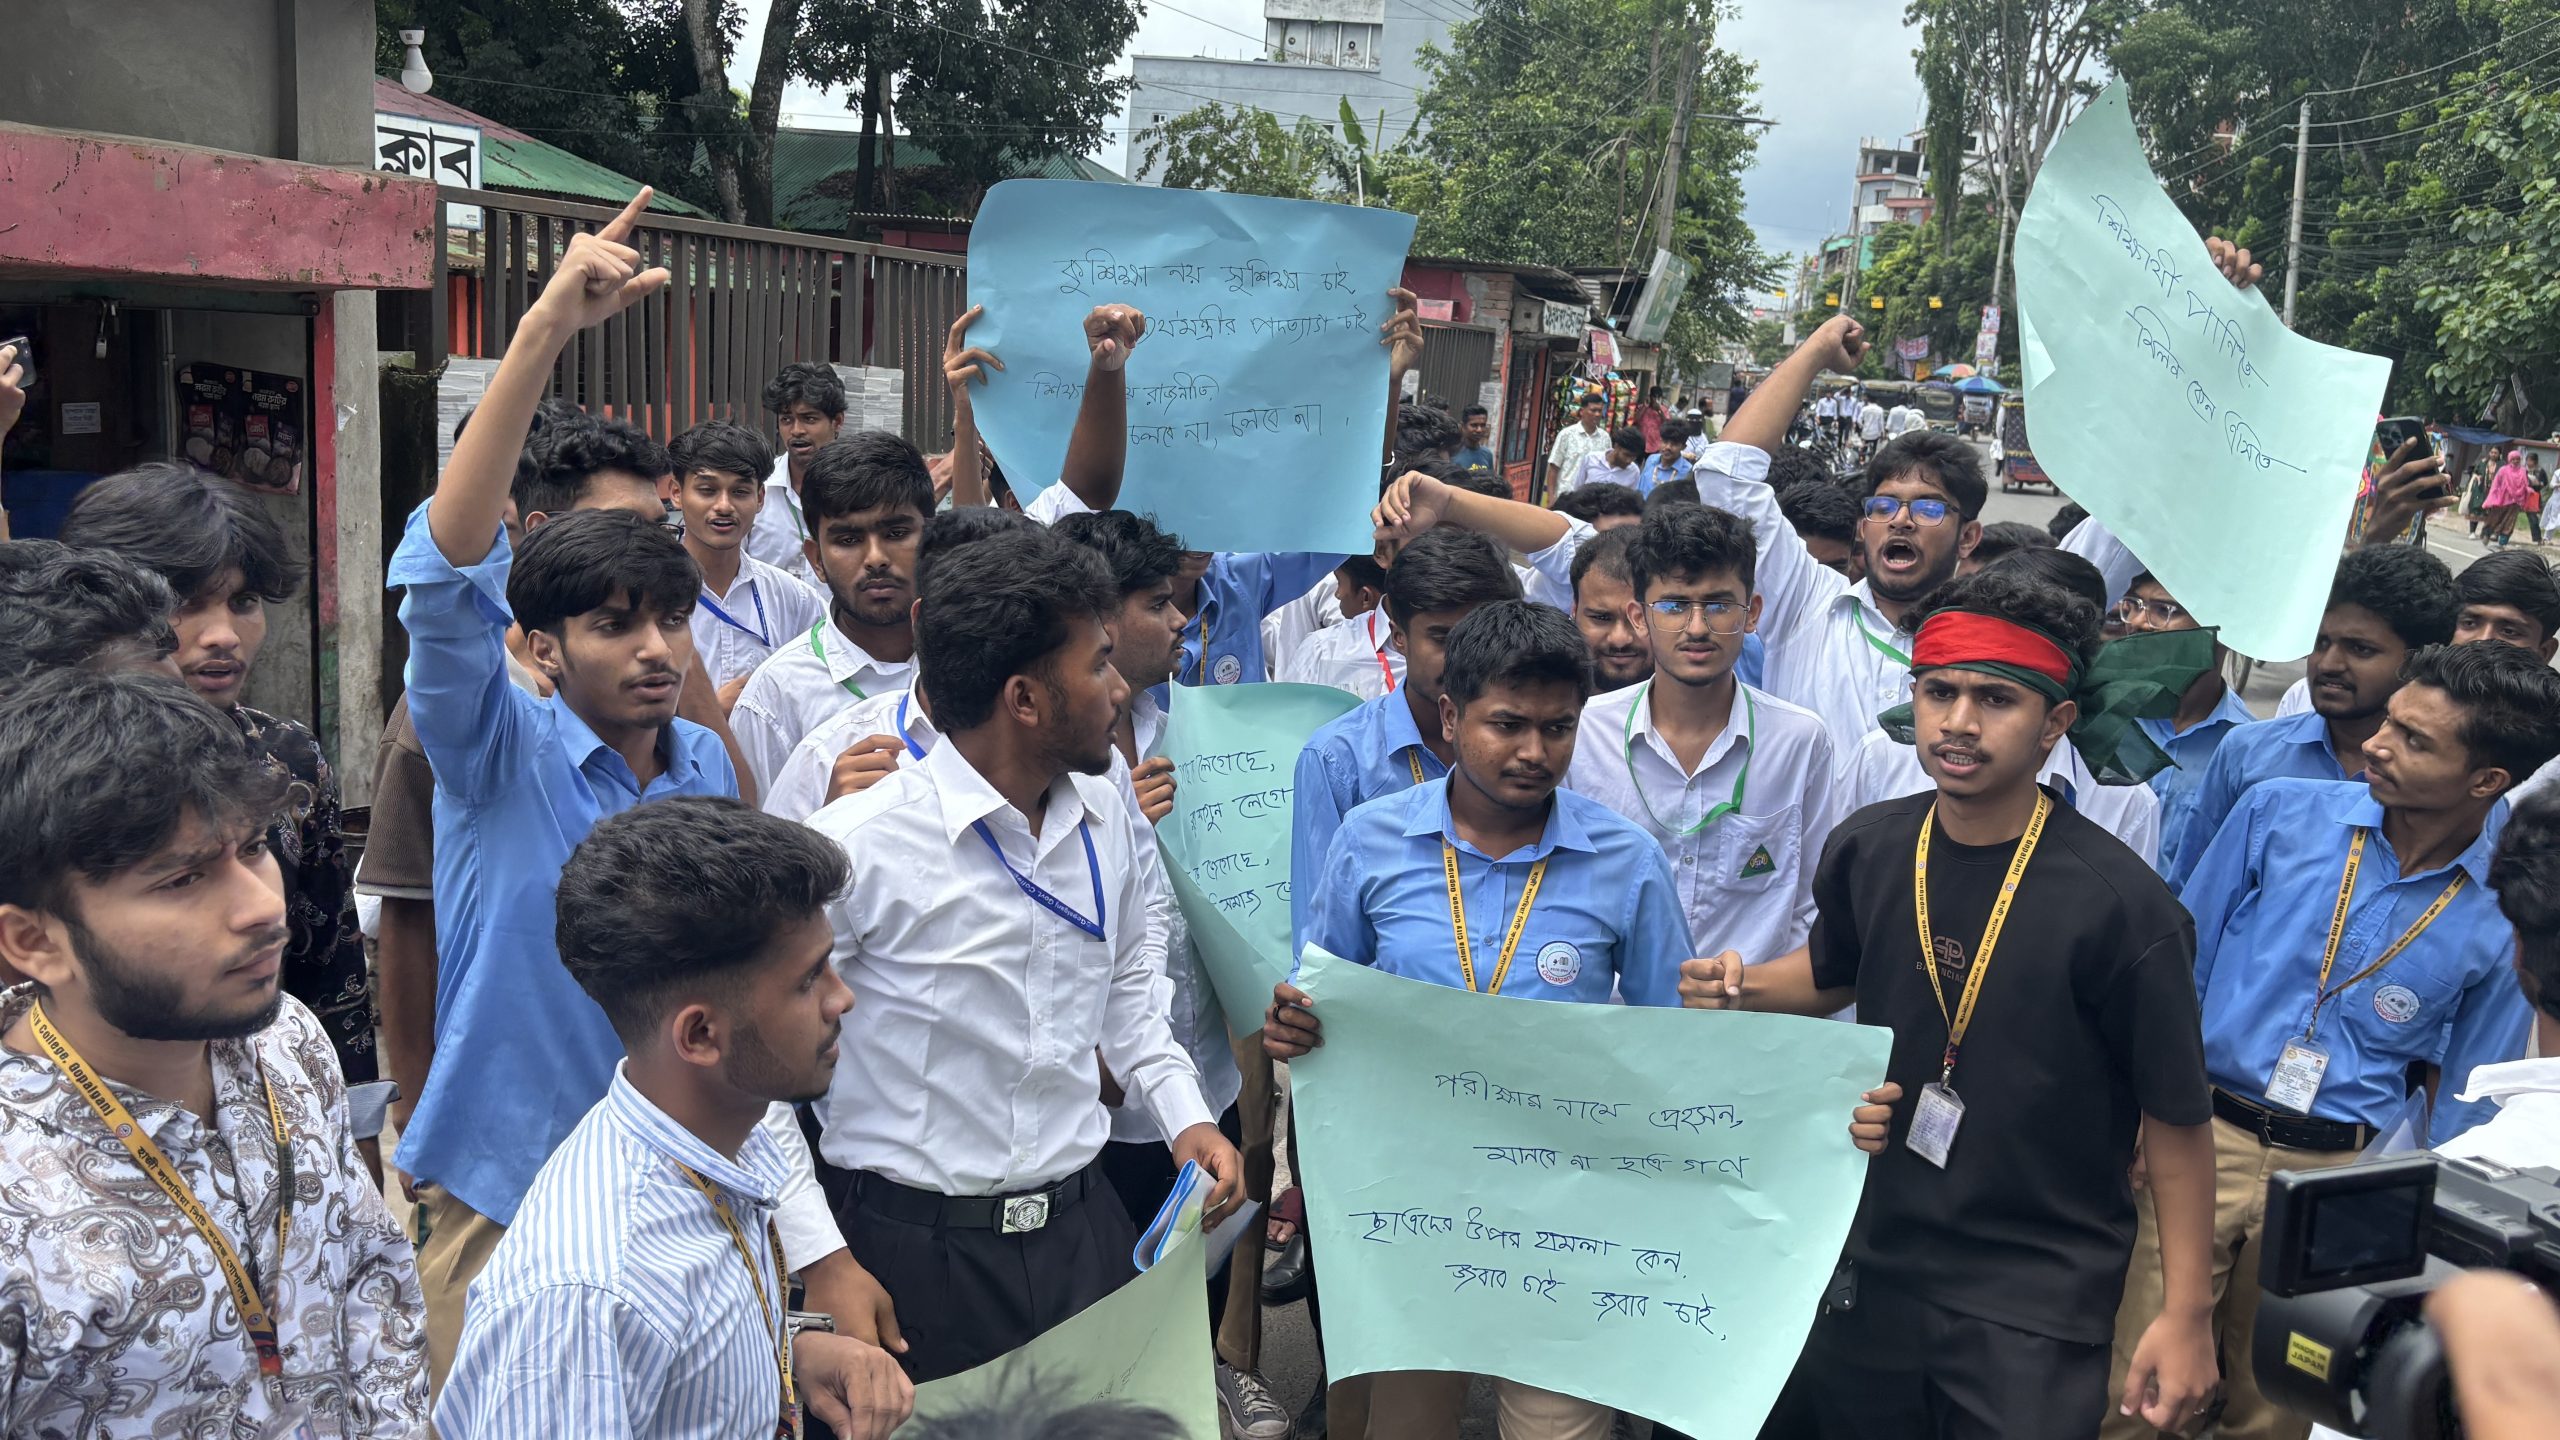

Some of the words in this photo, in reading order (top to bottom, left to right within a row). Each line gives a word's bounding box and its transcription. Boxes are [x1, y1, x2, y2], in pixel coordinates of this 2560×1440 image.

[1162, 263, 1204, 284] নয়
[1232, 788, 1294, 818] লেগে
[1455, 925, 1463, 940] City
[38, 1023, 69, 1065] College,
[68, 1062, 114, 1117] Gopalganj
[1553, 1098, 1631, 1125] নামে
[1570, 1154, 1599, 1170] না
[136, 1145, 159, 1174] হাজী
[190, 1204, 208, 1227] সিটি
[1465, 1207, 1522, 1250] উপর
[1534, 1230, 1622, 1257] হামলা
[2291, 1352, 2324, 1372] JAPAN
